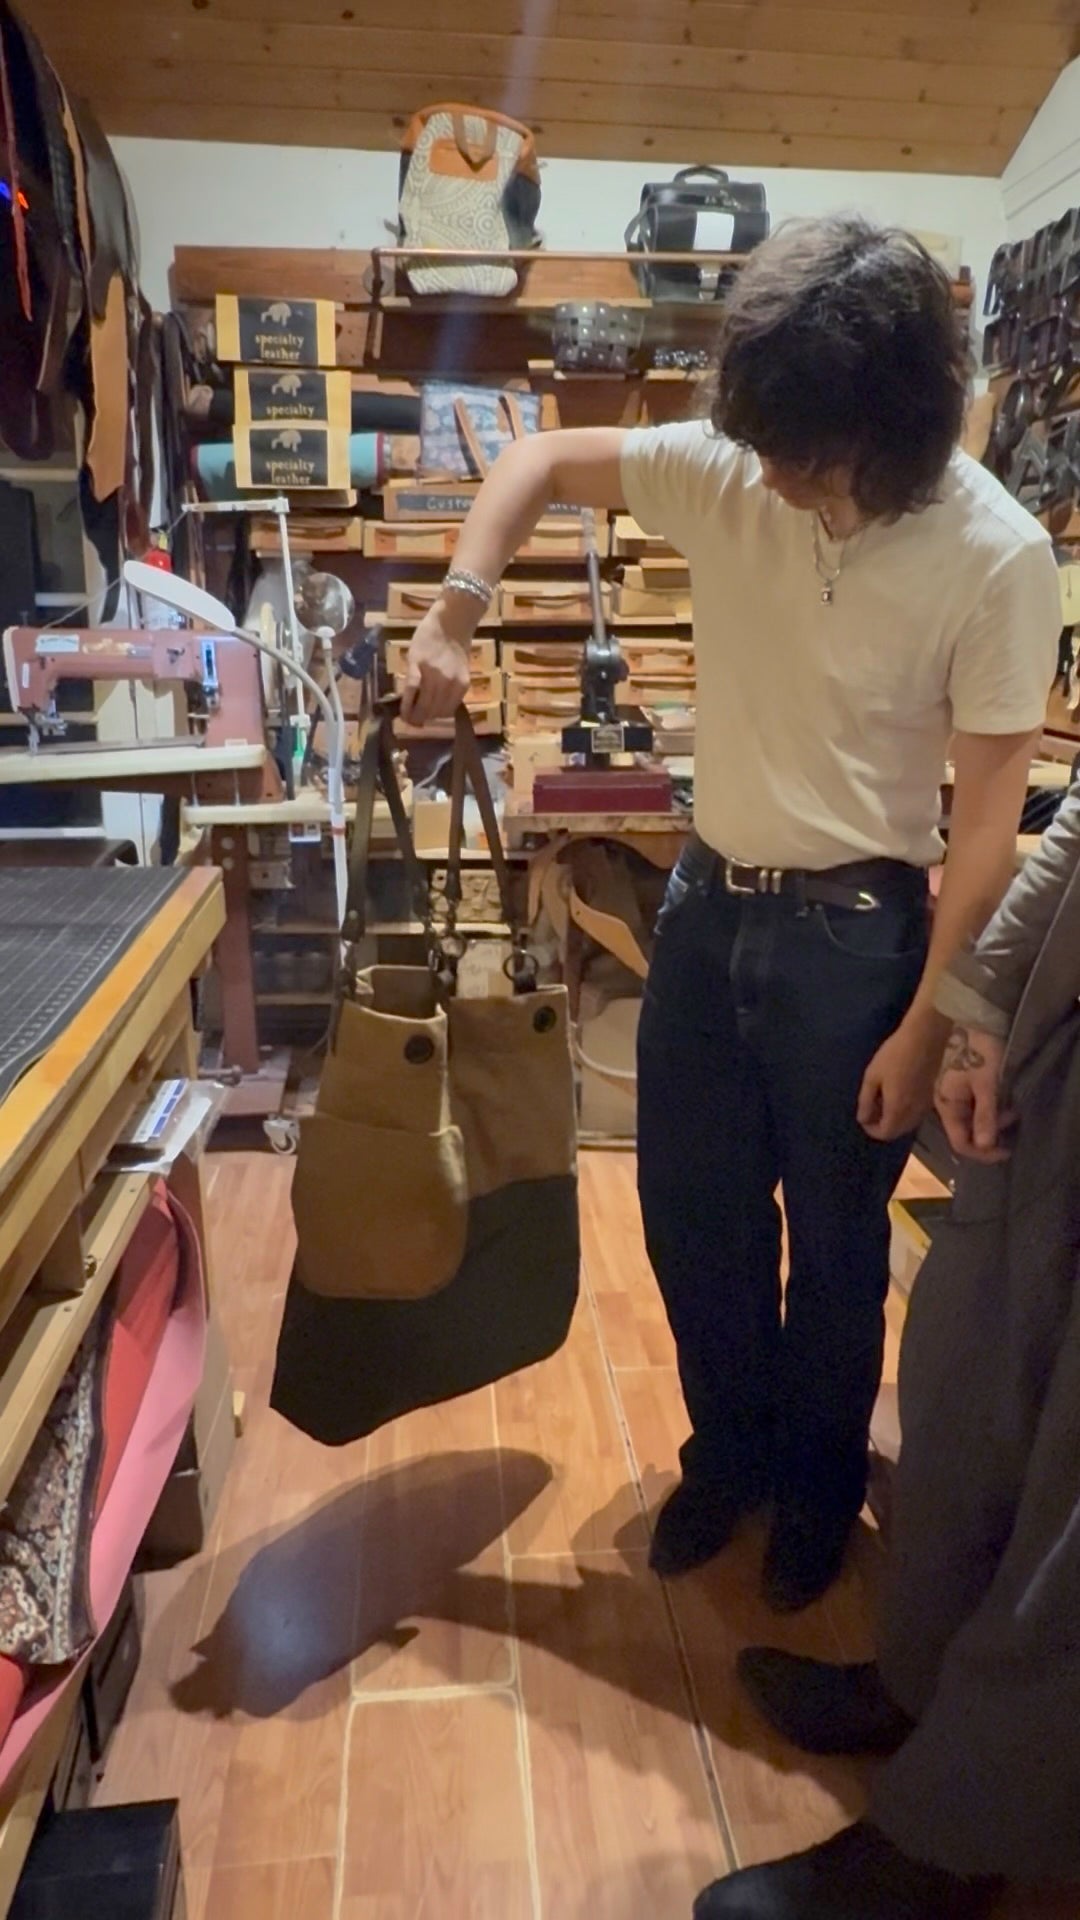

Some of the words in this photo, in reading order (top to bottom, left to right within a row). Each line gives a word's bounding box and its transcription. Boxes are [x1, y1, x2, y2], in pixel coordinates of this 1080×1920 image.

[255, 333, 305, 349] specialty
[260, 344, 300, 360] leather
[266, 403, 315, 418] specialty
[265, 458, 315, 473] specialty
[271, 469, 310, 485] leather
